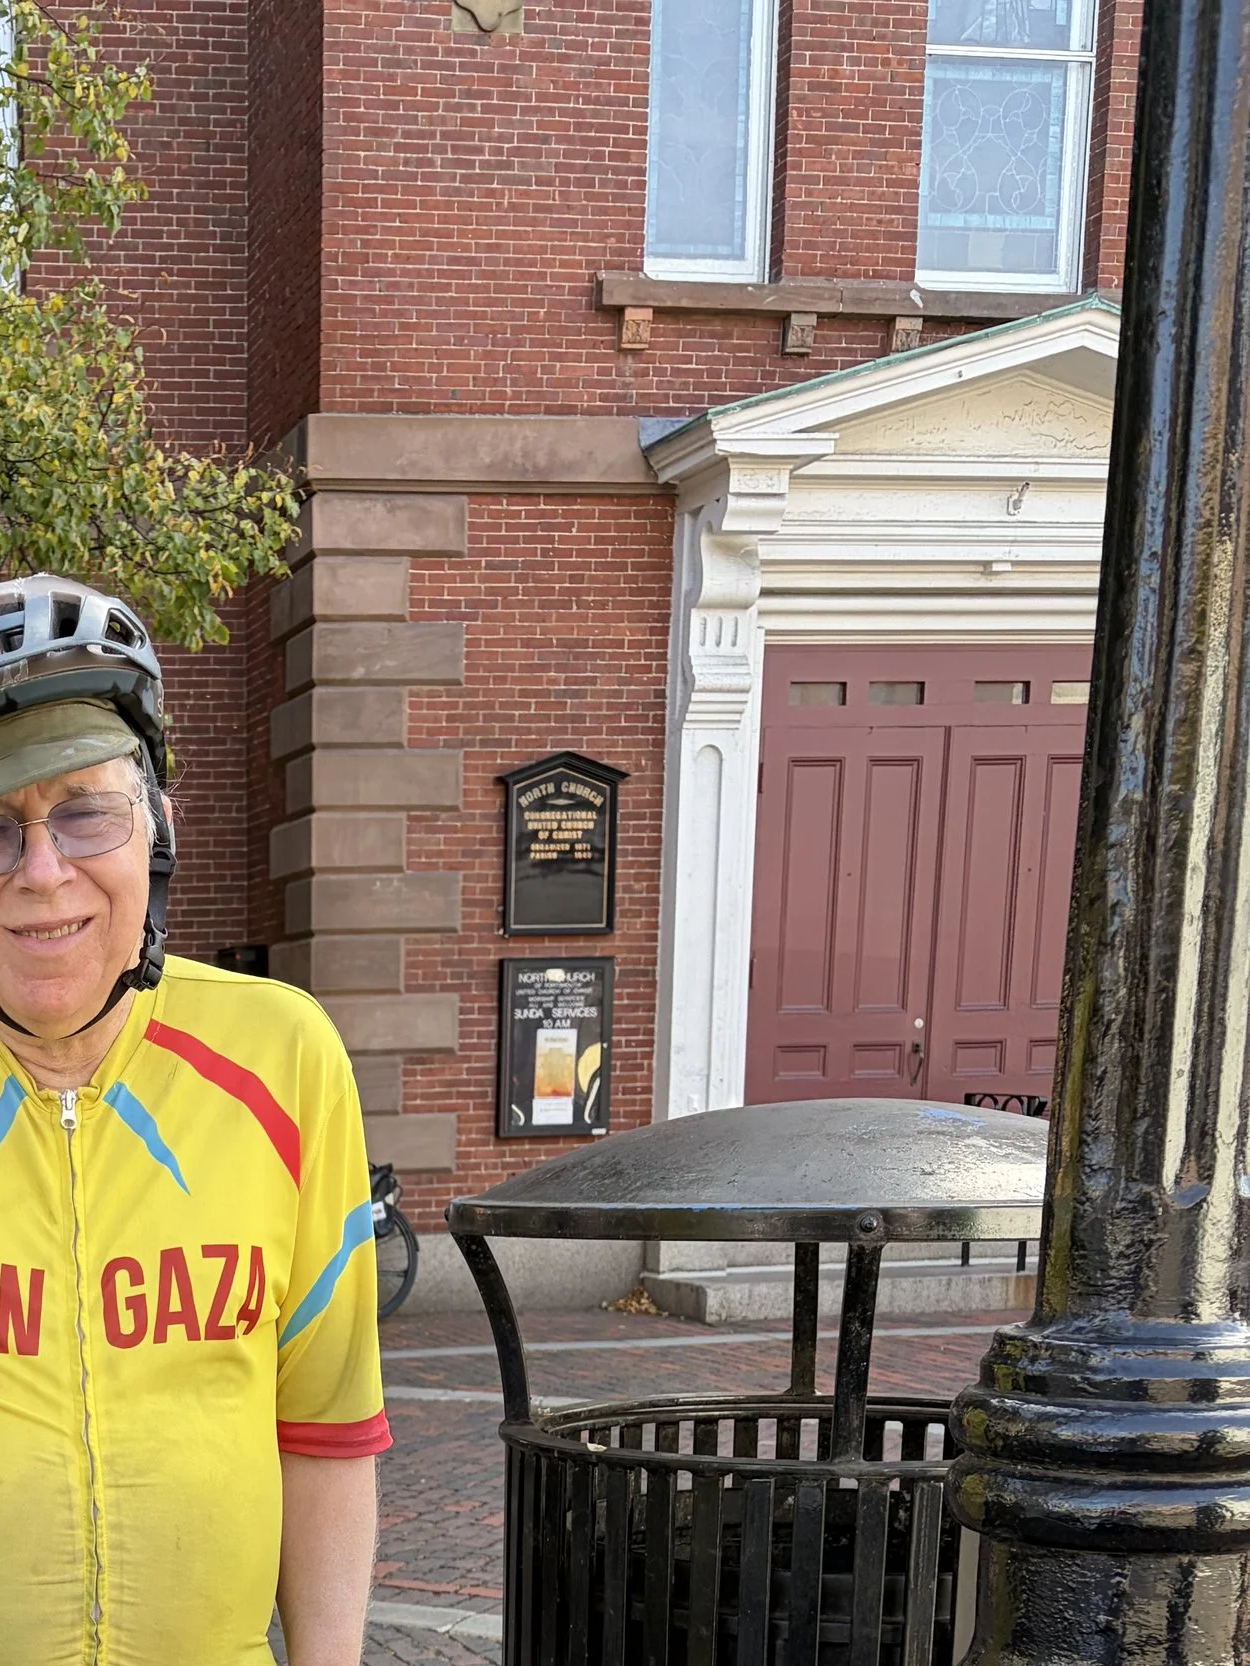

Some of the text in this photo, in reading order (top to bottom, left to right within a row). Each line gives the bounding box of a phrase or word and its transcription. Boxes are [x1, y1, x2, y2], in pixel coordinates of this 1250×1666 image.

[518, 781, 604, 808] NORTH CHURCH
[524, 811, 597, 820] CONGREGATIONAL
[527, 821, 594, 830] UNITED CHURCH
[538, 831, 583, 840] OF CHRIST
[551, 1006, 598, 1018] SERVICES
[101, 1244, 266, 1349] GAZA
